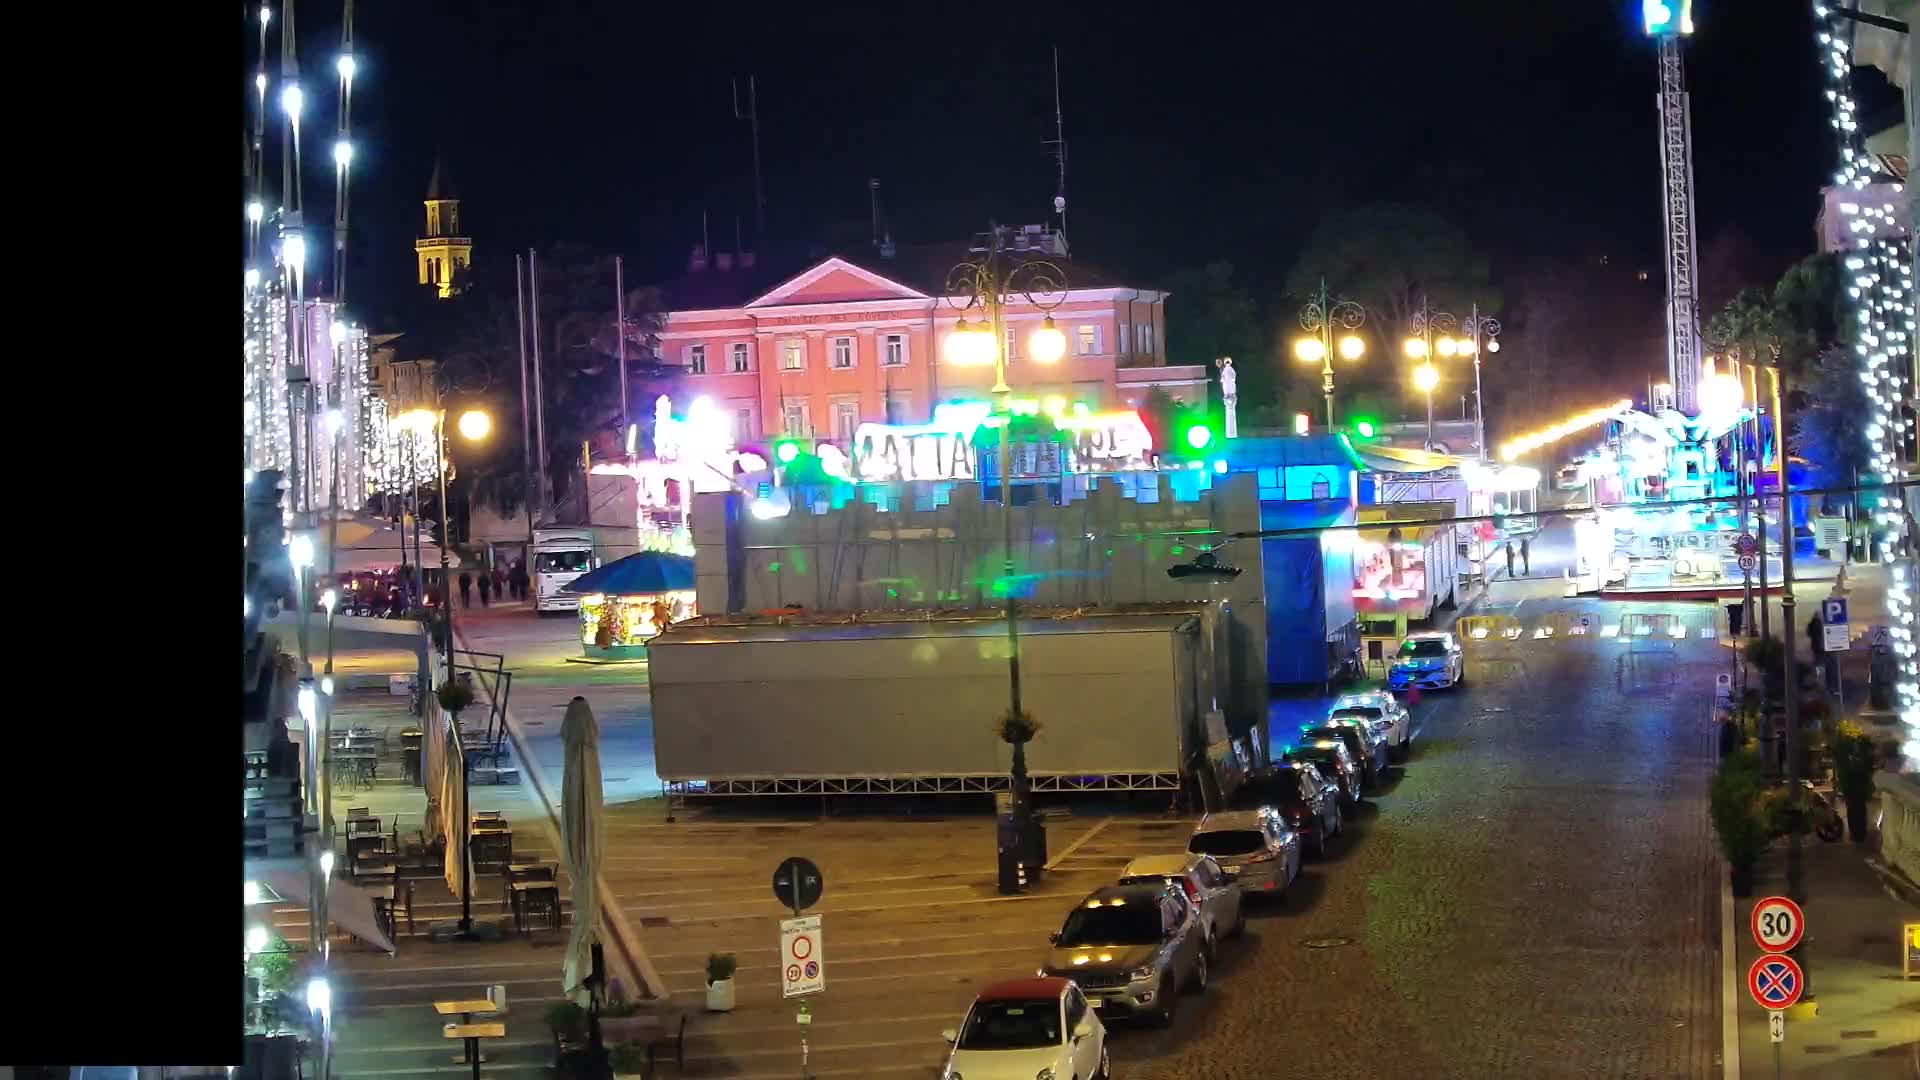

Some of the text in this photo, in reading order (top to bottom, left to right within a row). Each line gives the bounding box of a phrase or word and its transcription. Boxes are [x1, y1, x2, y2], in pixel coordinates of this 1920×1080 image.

[1742, 558, 1753, 567] 20
[1827, 602, 1842, 622] P
[1762, 912, 1791, 938] 30
